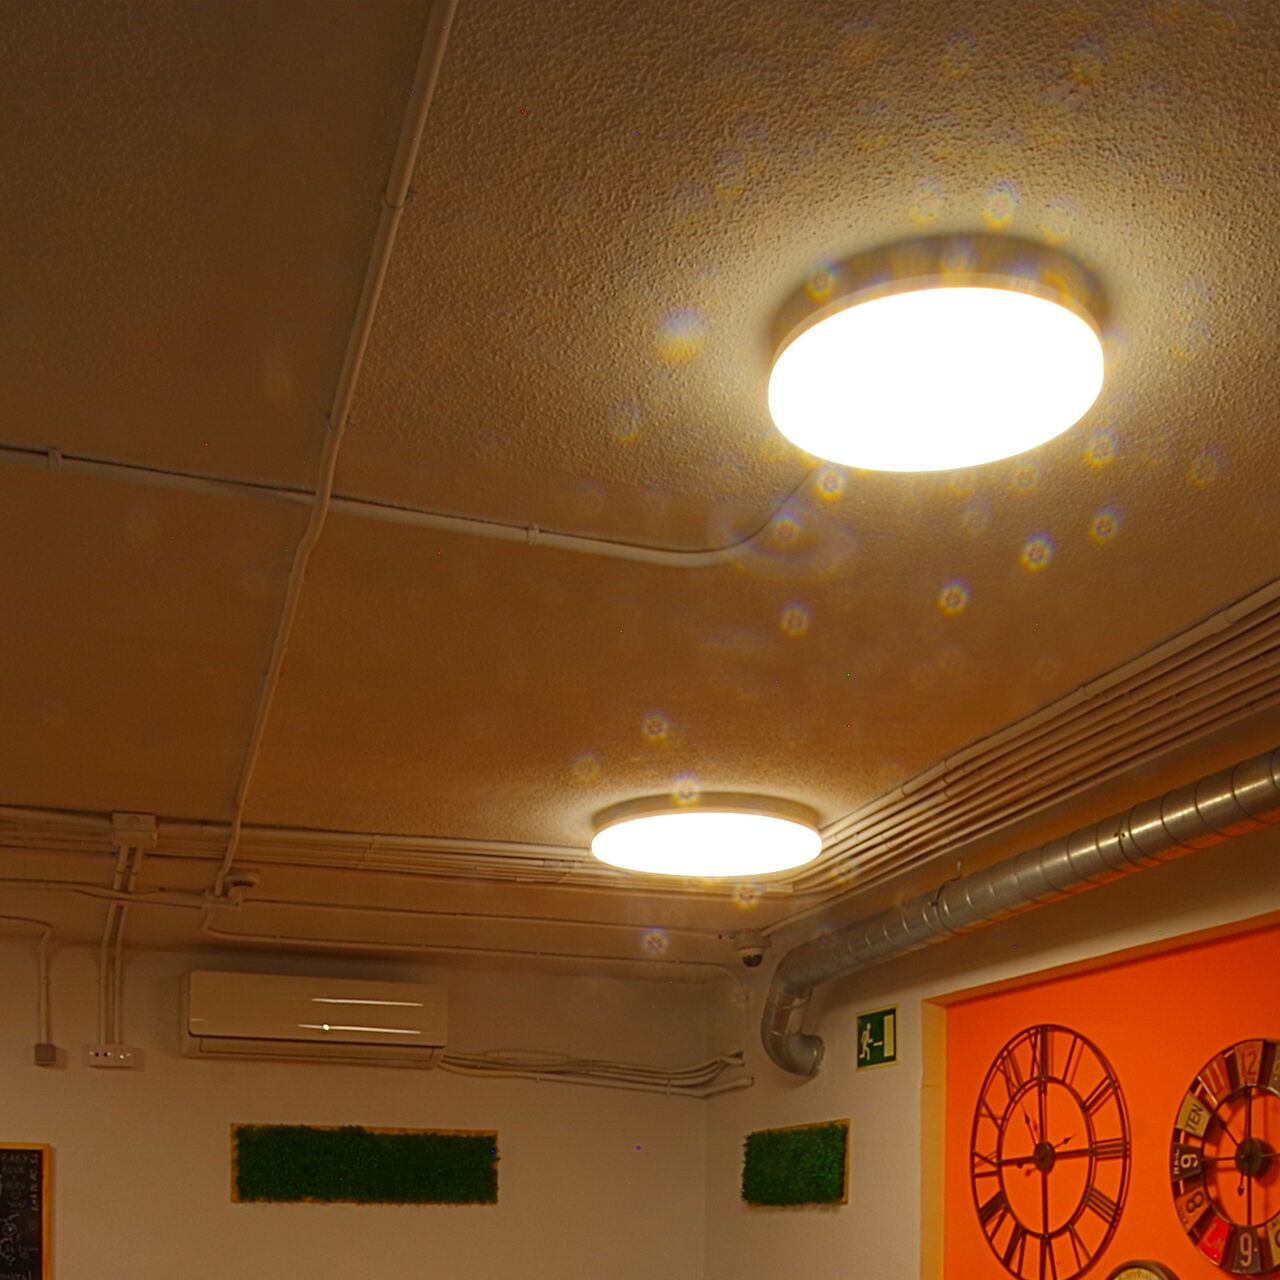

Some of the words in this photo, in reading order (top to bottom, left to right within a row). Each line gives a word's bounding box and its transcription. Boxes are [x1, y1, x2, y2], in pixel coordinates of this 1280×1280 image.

[1241, 1051, 1257, 1077] 12
[1185, 1105, 1202, 1131] TEN
[1185, 1192, 1204, 1214] 8
